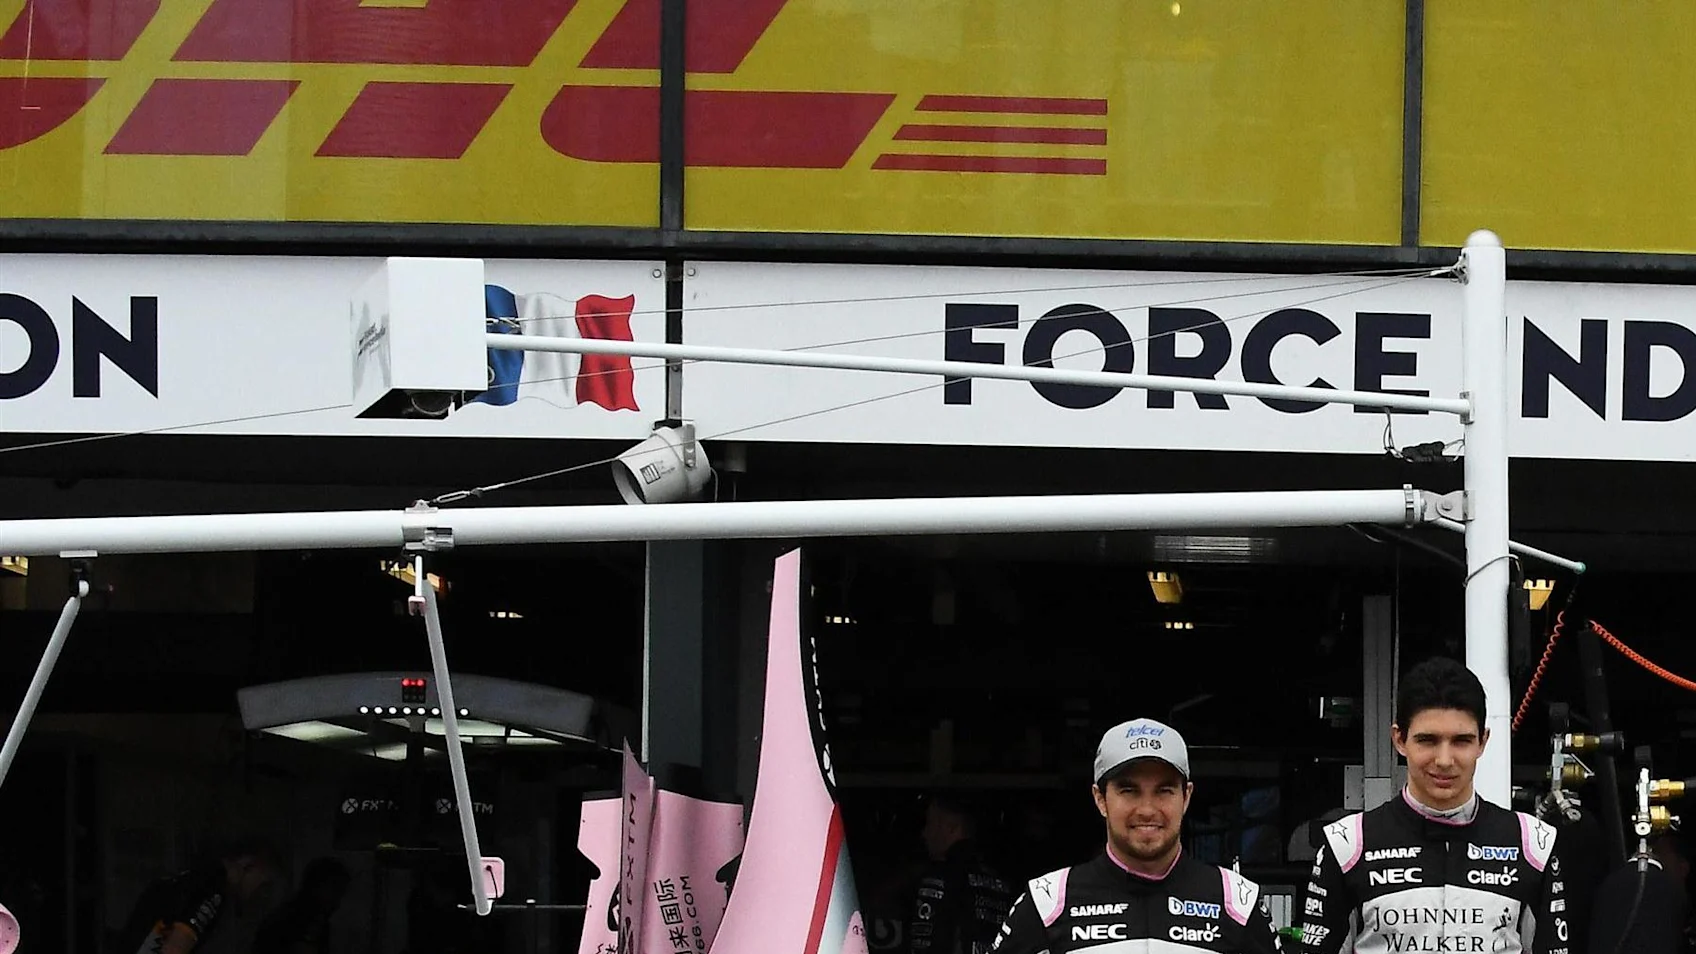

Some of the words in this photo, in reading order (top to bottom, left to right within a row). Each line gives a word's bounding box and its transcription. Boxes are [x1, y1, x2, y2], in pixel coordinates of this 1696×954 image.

[944, 303, 1431, 414] FORCE
[1125, 724, 1165, 739] telcel
[1129, 737, 1149, 750] citi
[1365, 846, 1417, 861] SAHARA
[1482, 846, 1520, 861] BWT
[1369, 867, 1423, 886] NEC
[1467, 868, 1517, 886] Claro
[1070, 903, 1124, 917] SAHARA
[1183, 900, 1221, 919] BWT
[1373, 906, 1484, 932] JOHNNIE
[1071, 924, 1127, 941] NEC
[1168, 926, 1219, 942] Claro
[1382, 933, 1485, 953] WALKER
